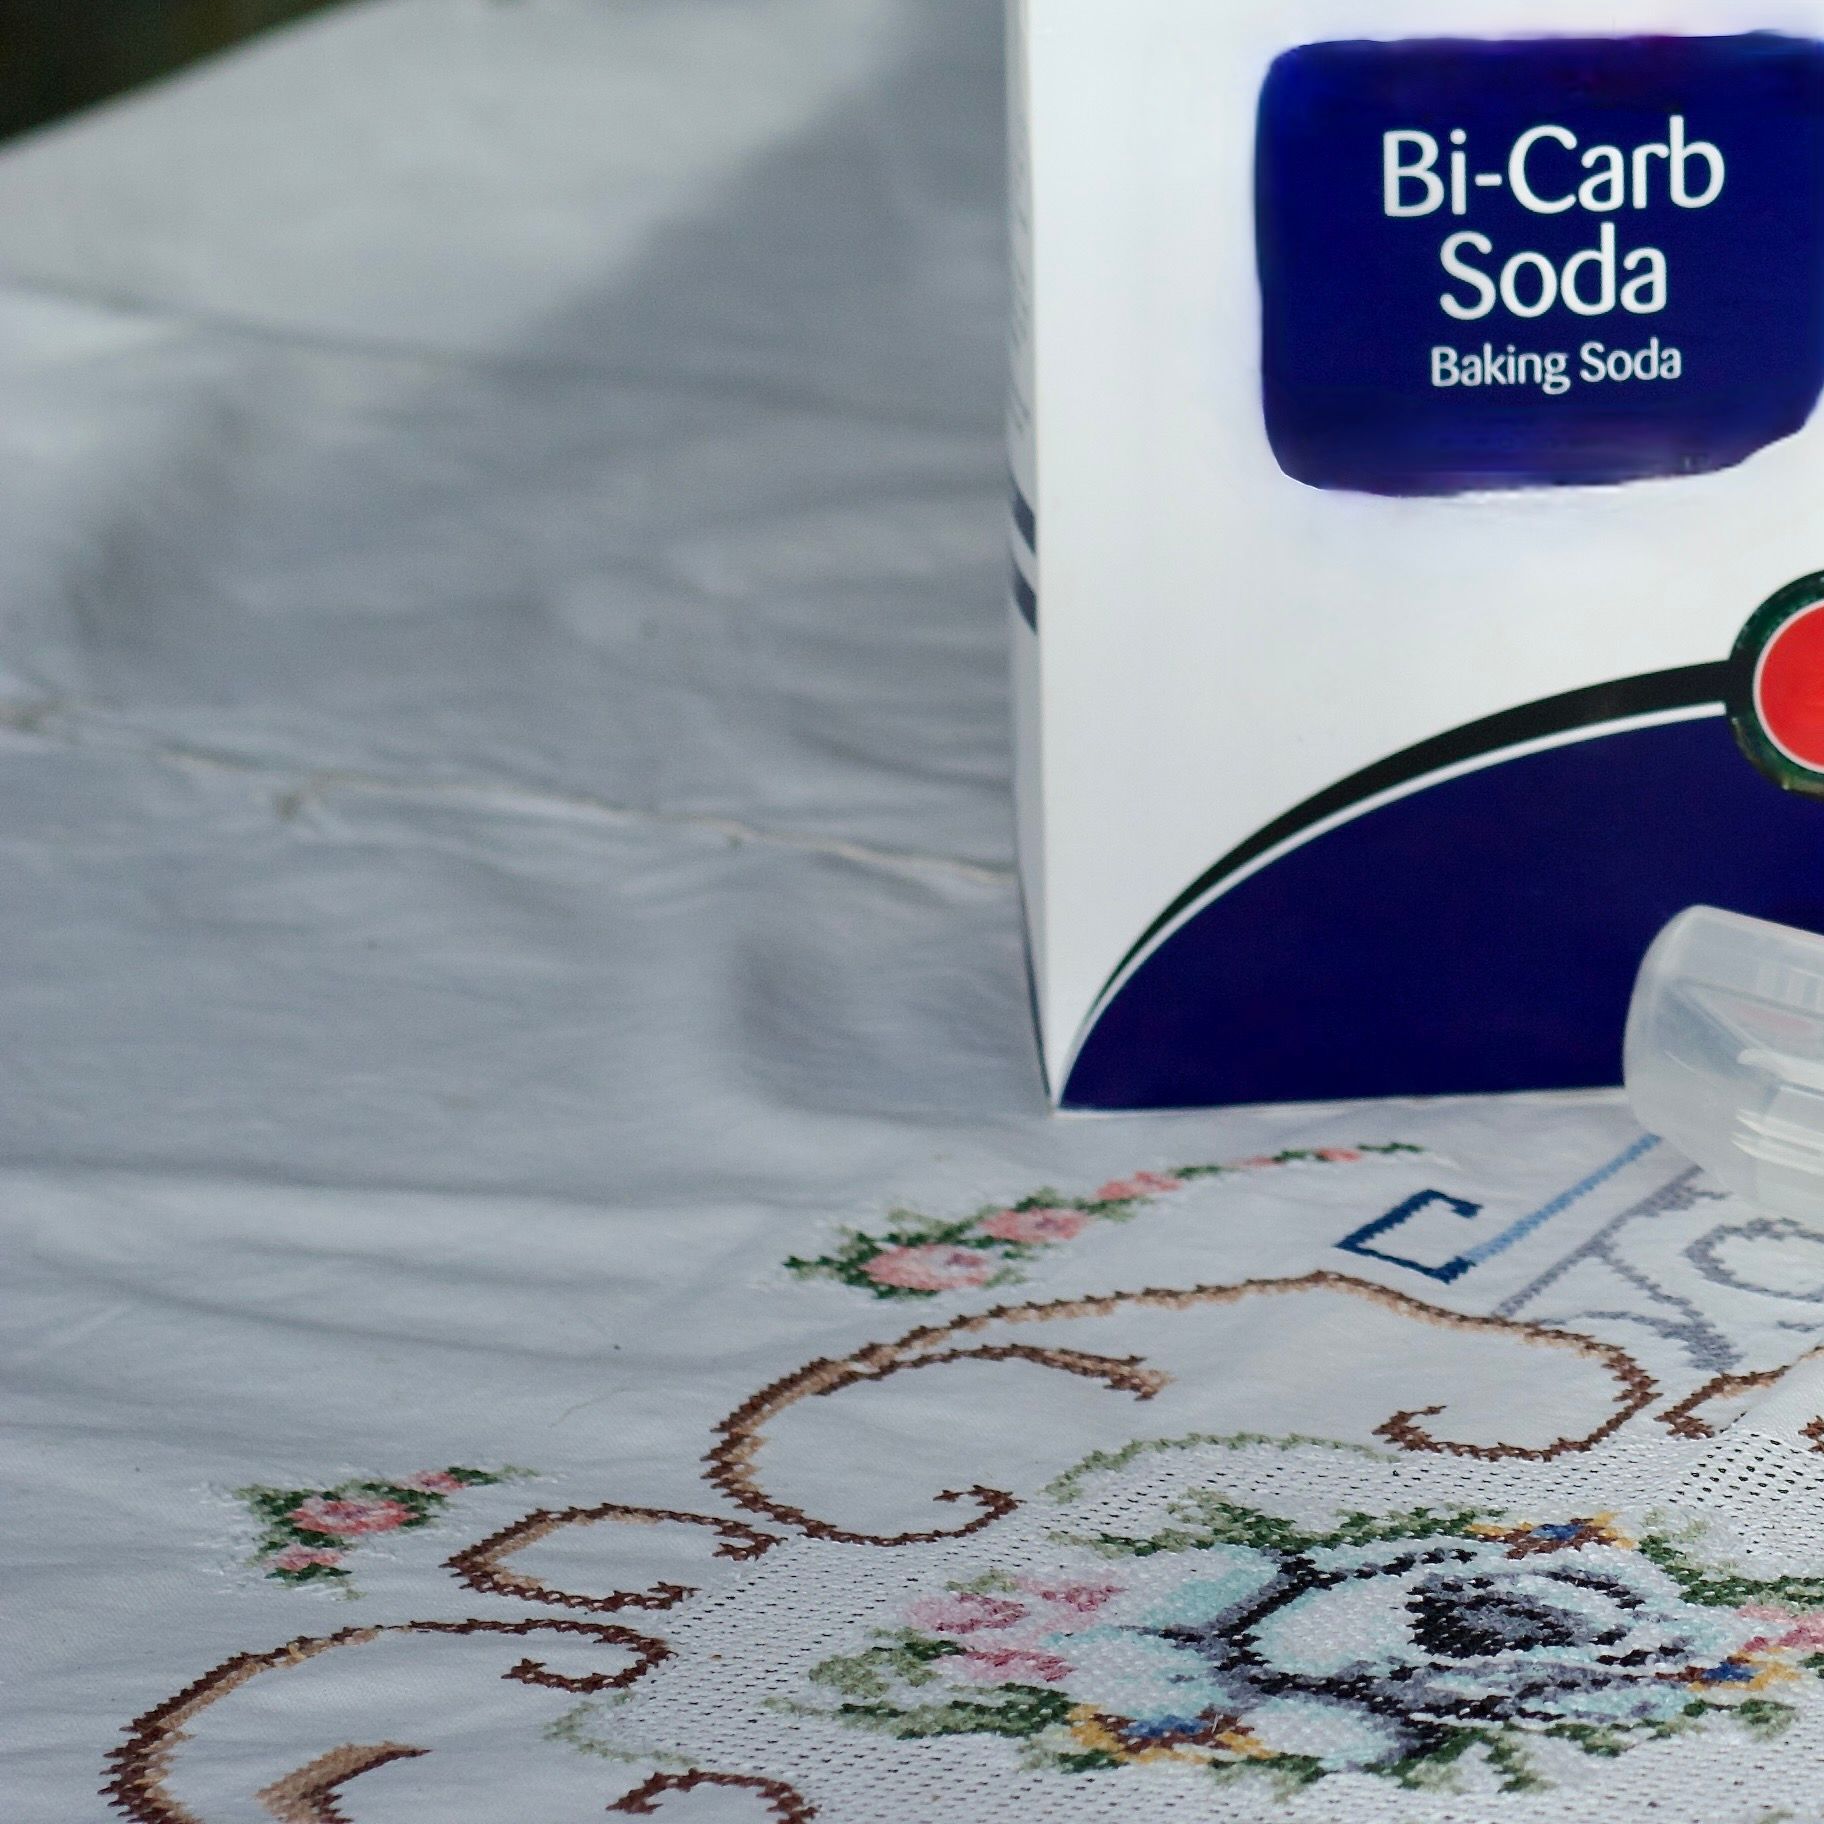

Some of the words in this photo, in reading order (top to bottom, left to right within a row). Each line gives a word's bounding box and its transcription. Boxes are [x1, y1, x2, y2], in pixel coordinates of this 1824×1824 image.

[1383, 114, 1726, 217] Bi-Carb
[1439, 222, 1667, 320] Soda
[1431, 342, 1571, 395] Baking
[1579, 336, 1682, 383] Soda
